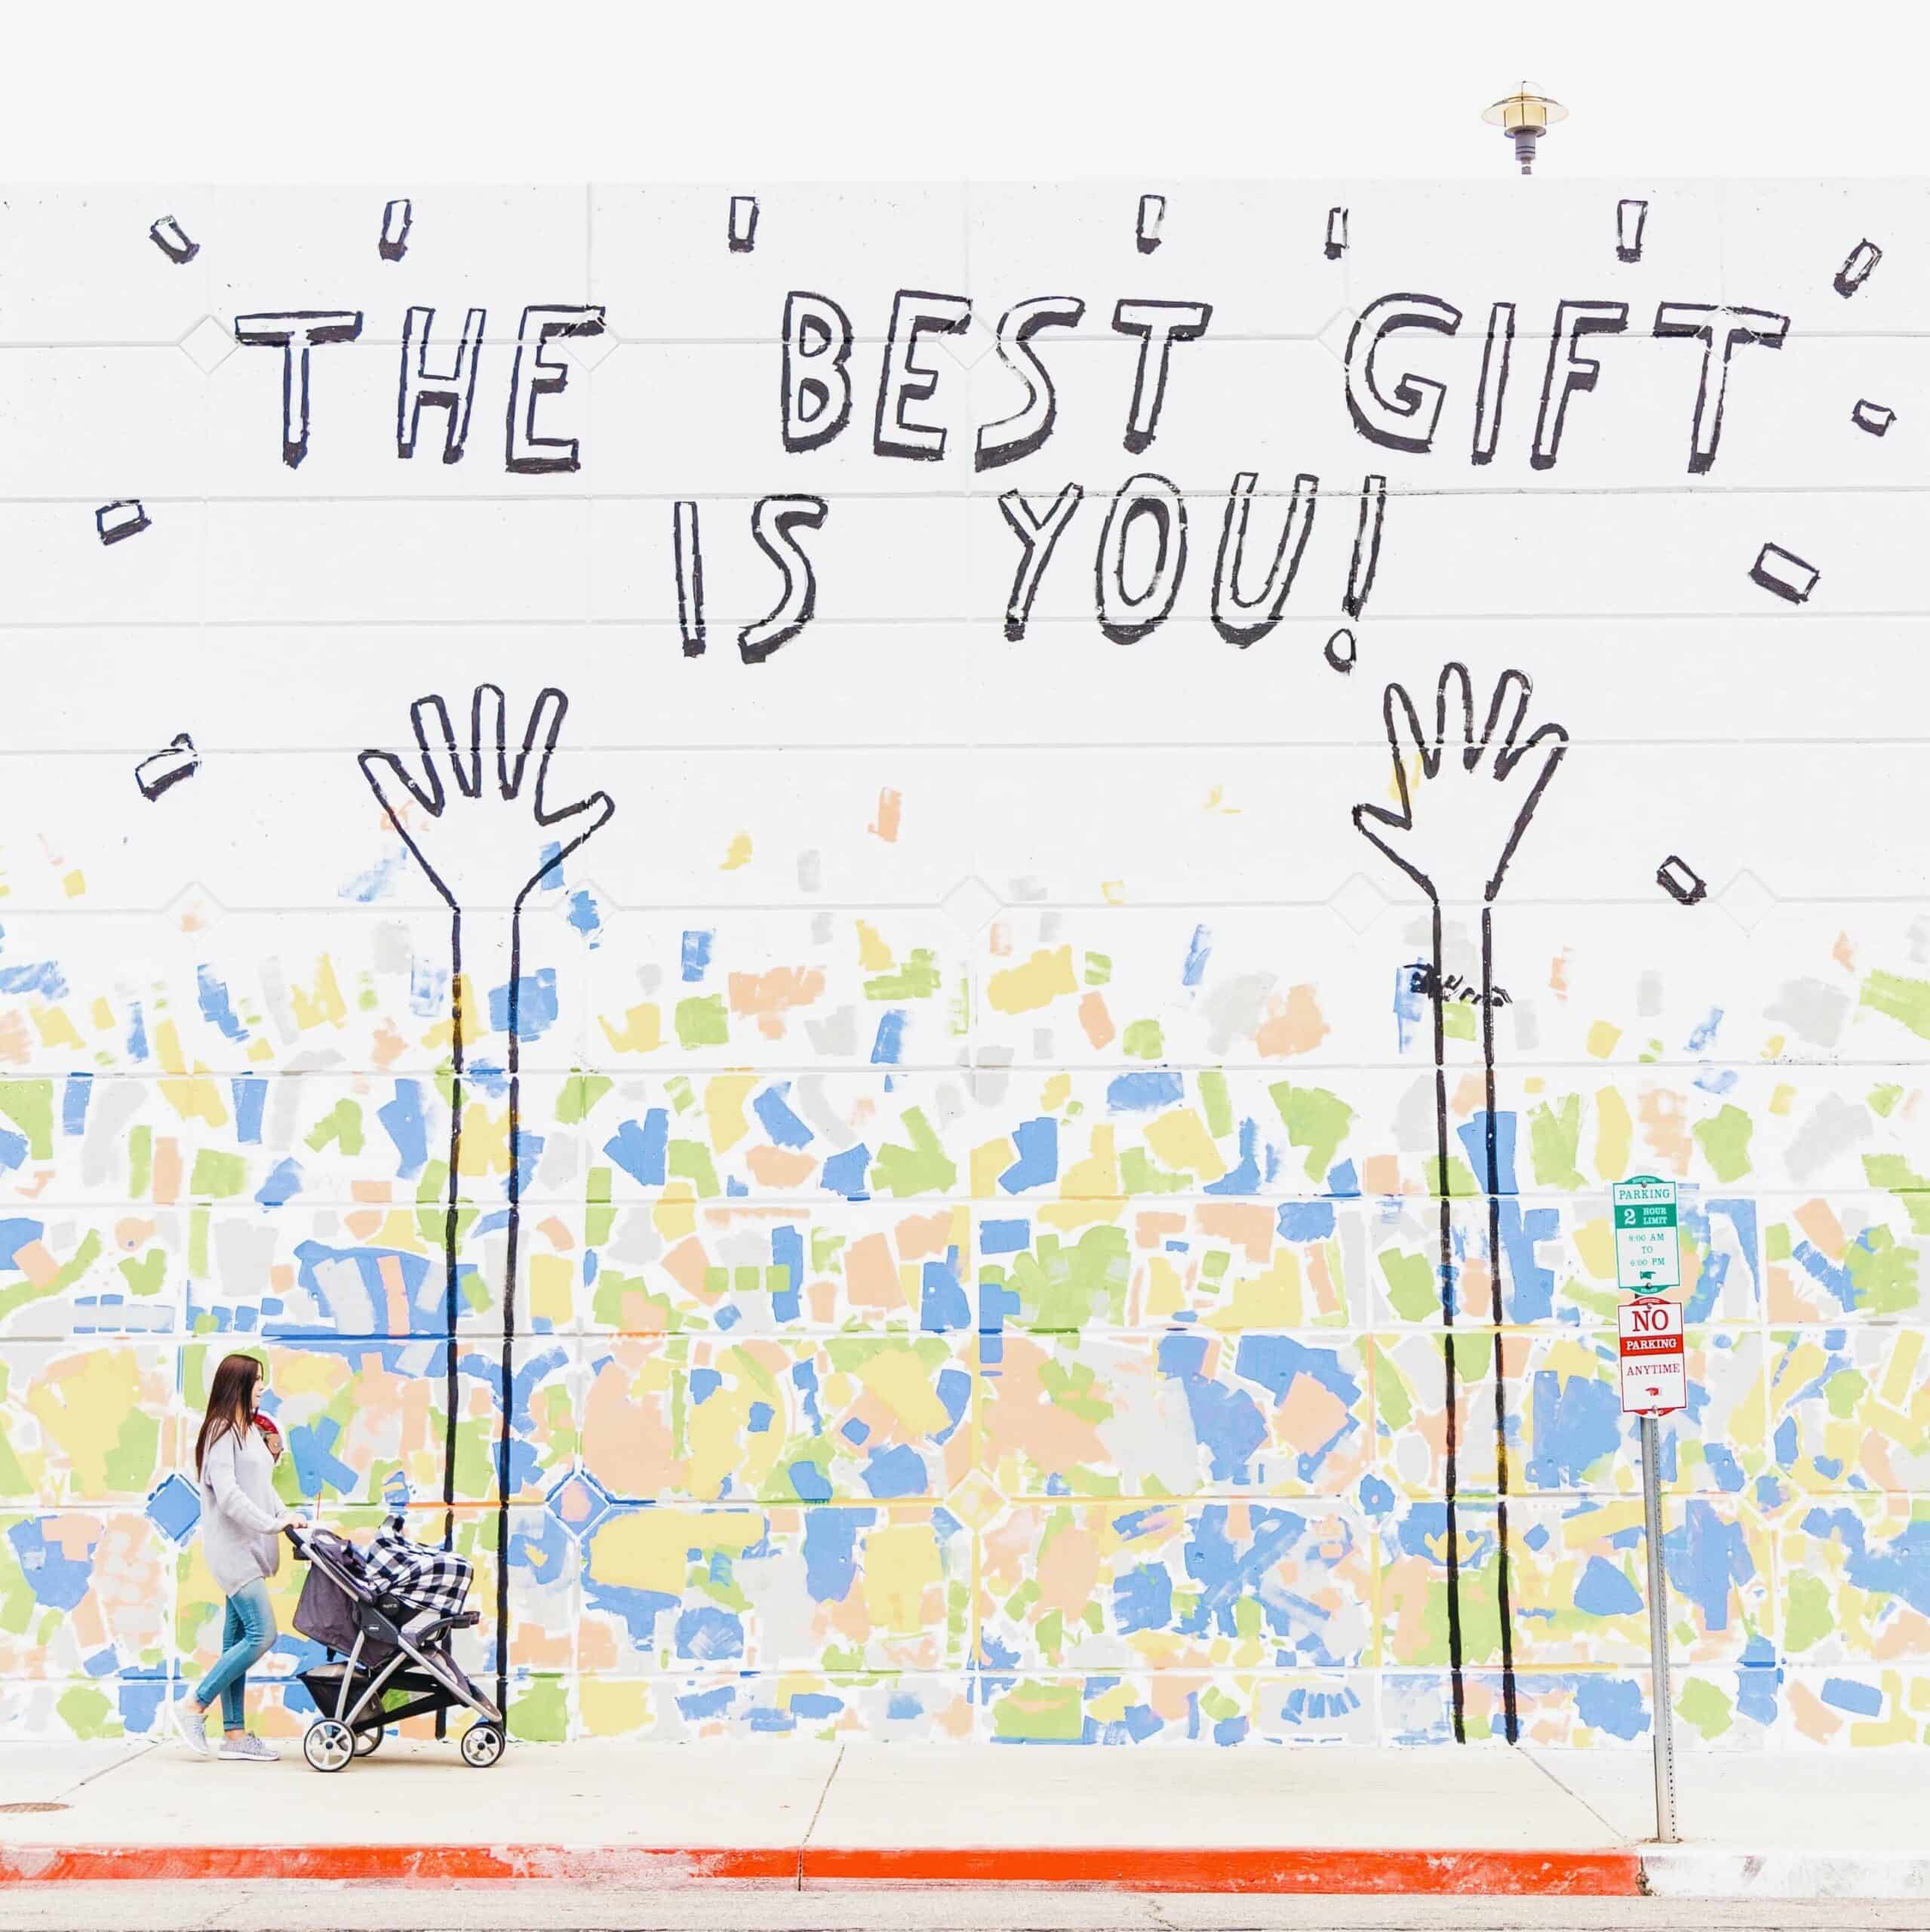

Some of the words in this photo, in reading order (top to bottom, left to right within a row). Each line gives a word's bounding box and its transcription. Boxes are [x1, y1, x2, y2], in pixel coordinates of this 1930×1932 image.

[235, 304, 606, 474] THE
[781, 291, 1212, 472] BEST
[1345, 293, 1790, 475] GIFT
[674, 494, 828, 664] IS
[997, 472, 1387, 674] YOU!
[1619, 1189, 1670, 1199] PARKING
[1624, 1208, 1636, 1225] 2
[1643, 1217, 1667, 1225] LIMIT
[1641, 1246, 1653, 1254] TO
[1652, 1257, 1665, 1266] PM
[1632, 1309, 1669, 1332] NO
[1627, 1338, 1676, 1350] PARKING
[1627, 1364, 1680, 1376] ANYTIME
